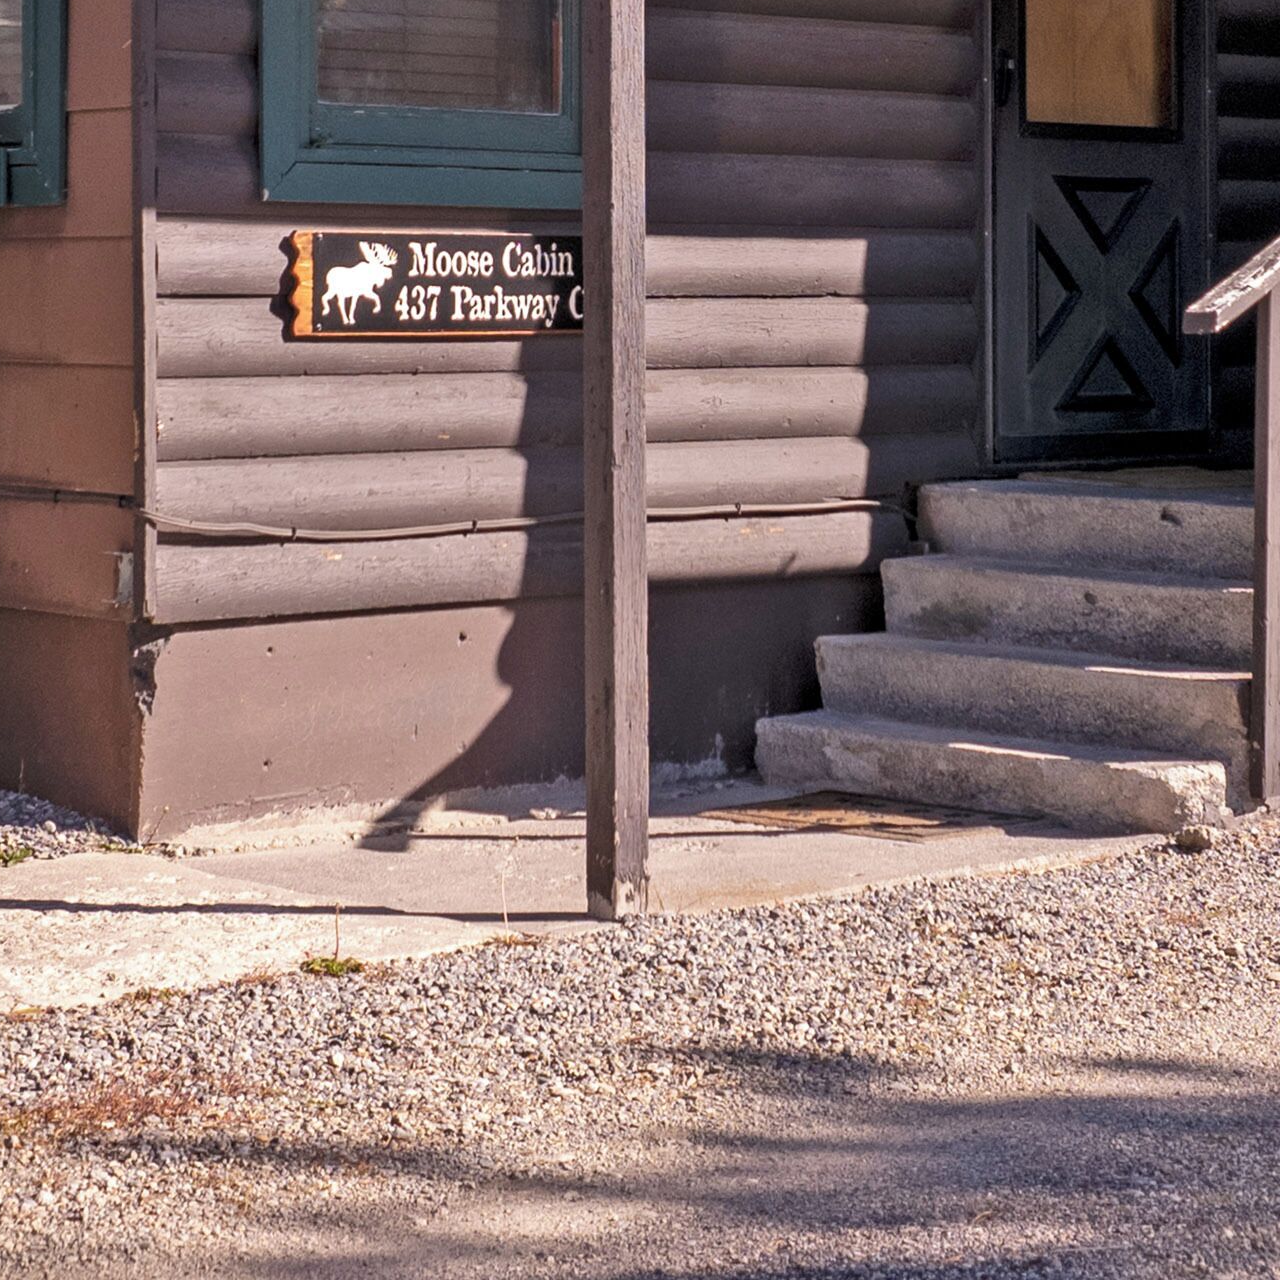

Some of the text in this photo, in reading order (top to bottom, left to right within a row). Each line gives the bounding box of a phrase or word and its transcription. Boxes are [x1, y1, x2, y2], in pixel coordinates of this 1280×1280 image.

[408, 241, 575, 277] Moose Cabin
[394, 285, 443, 321] 437
[450, 285, 560, 328] Parkway
